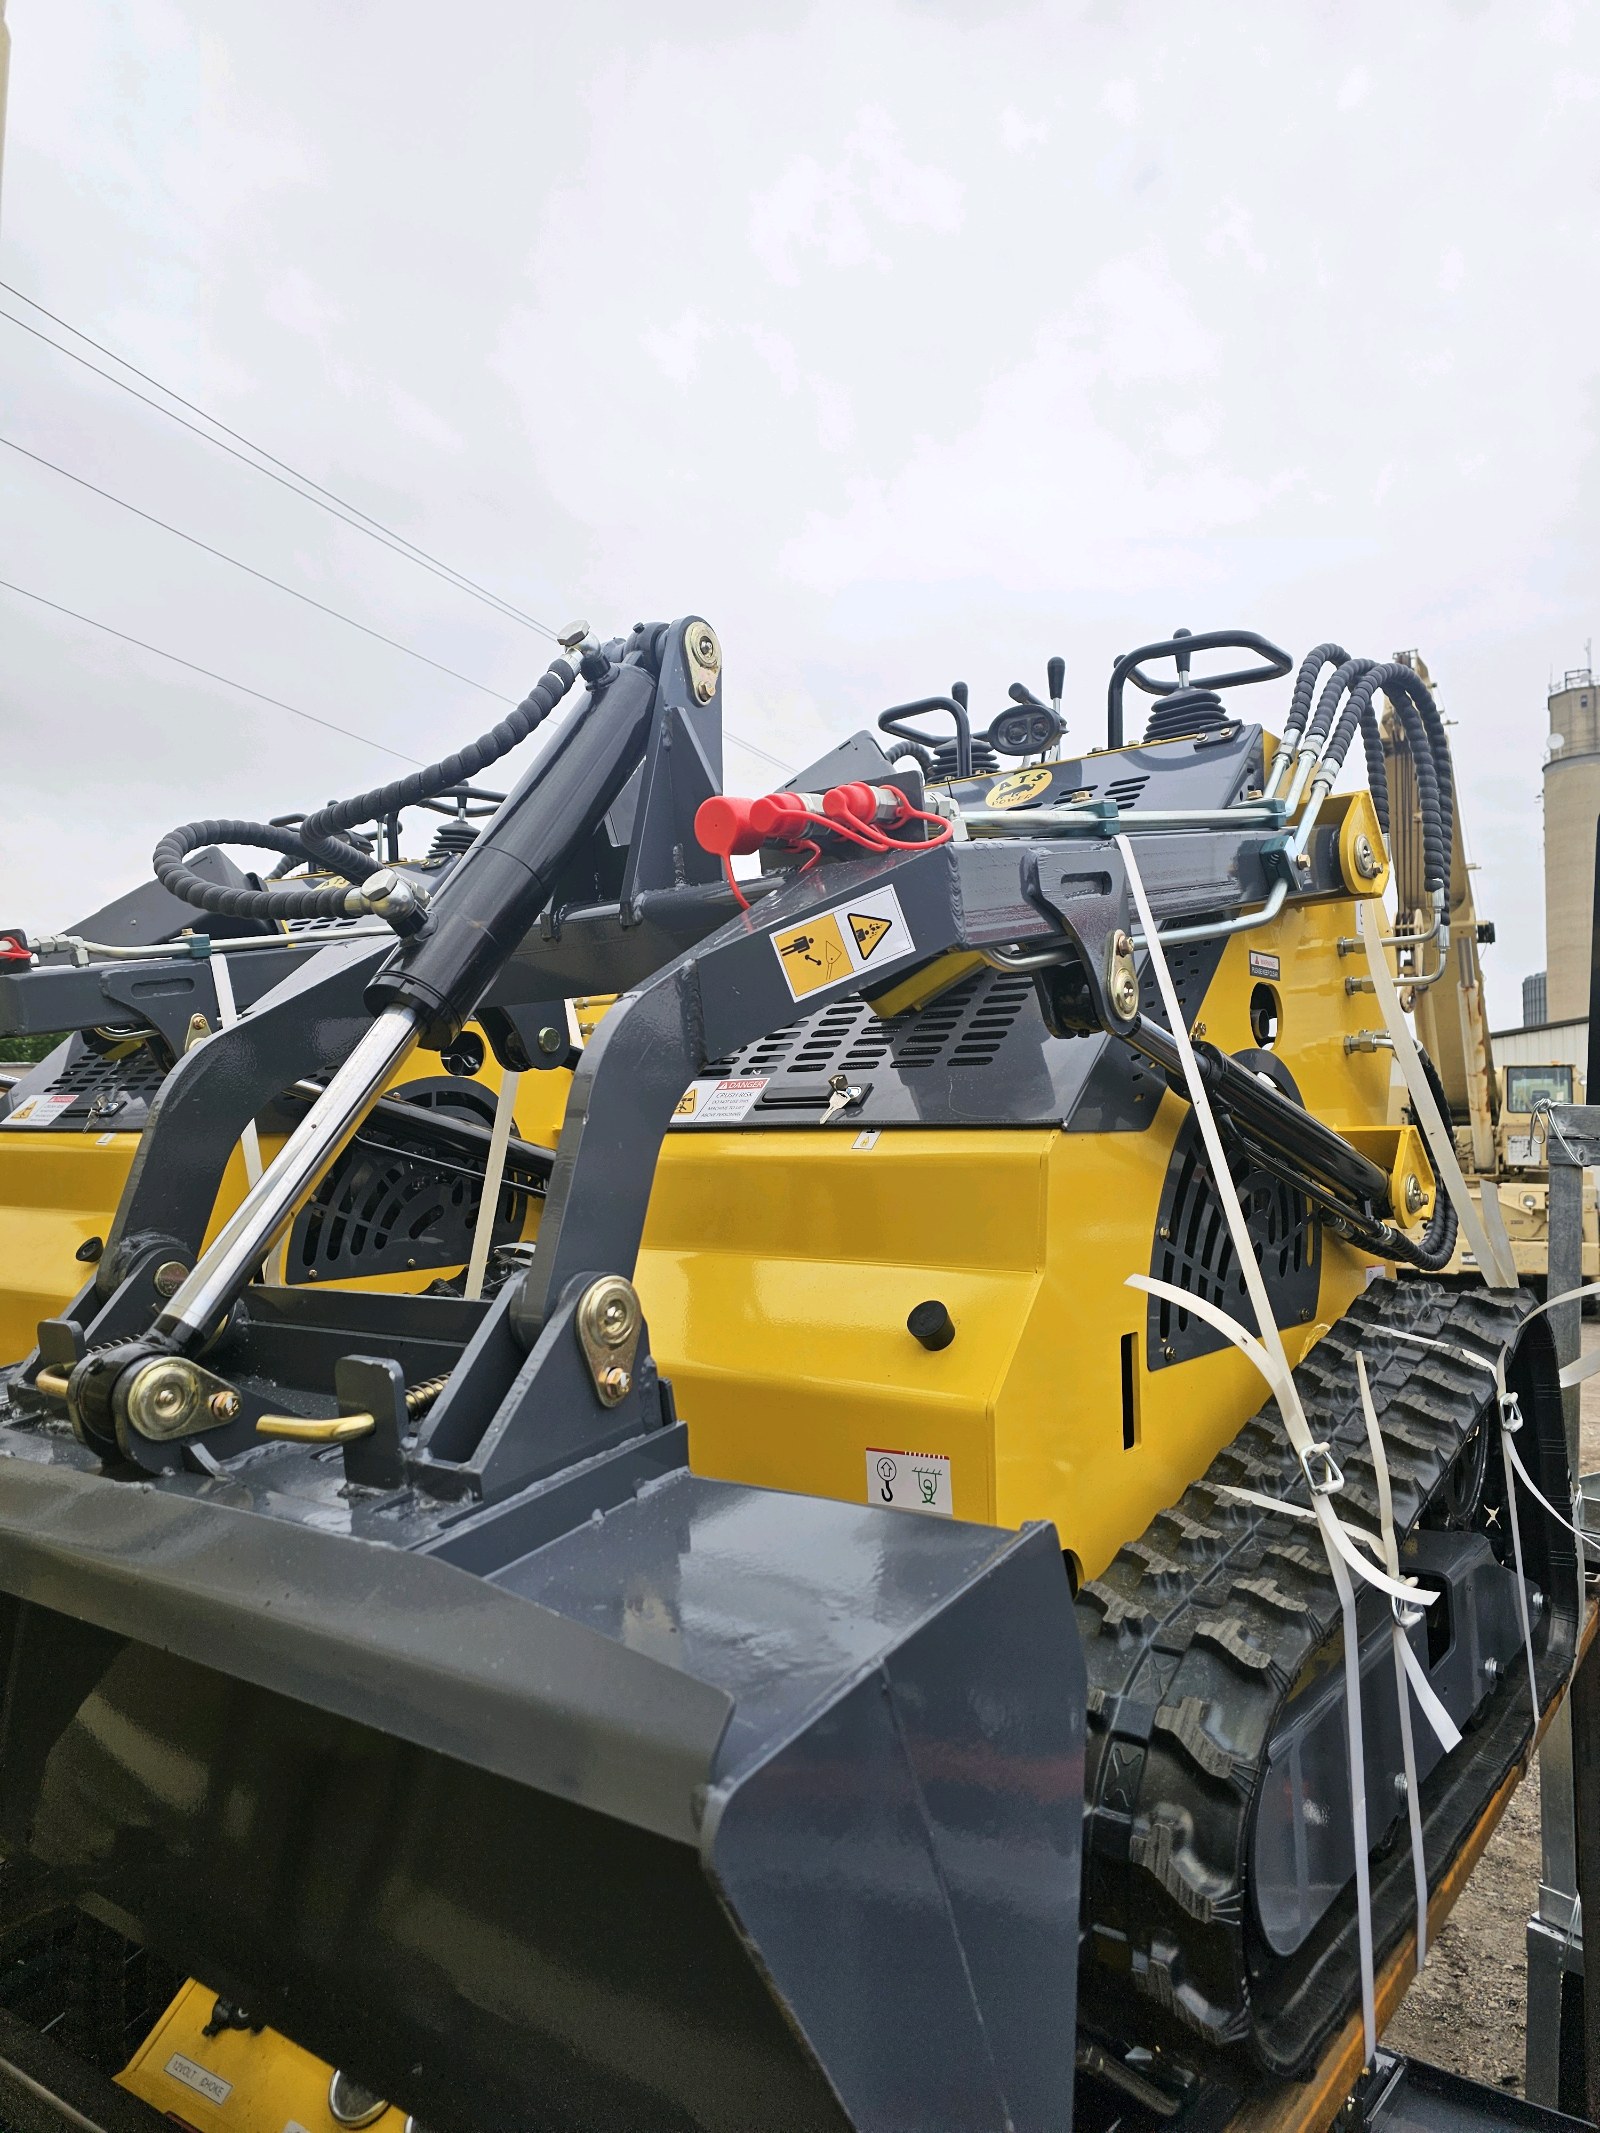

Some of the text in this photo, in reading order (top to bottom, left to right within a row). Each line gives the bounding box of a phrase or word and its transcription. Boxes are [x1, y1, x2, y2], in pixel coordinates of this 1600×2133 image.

[999, 773, 1048, 791] ATS
[728, 1080, 764, 1089] DANGER
[199, 2077, 224, 2097] CHOKE
